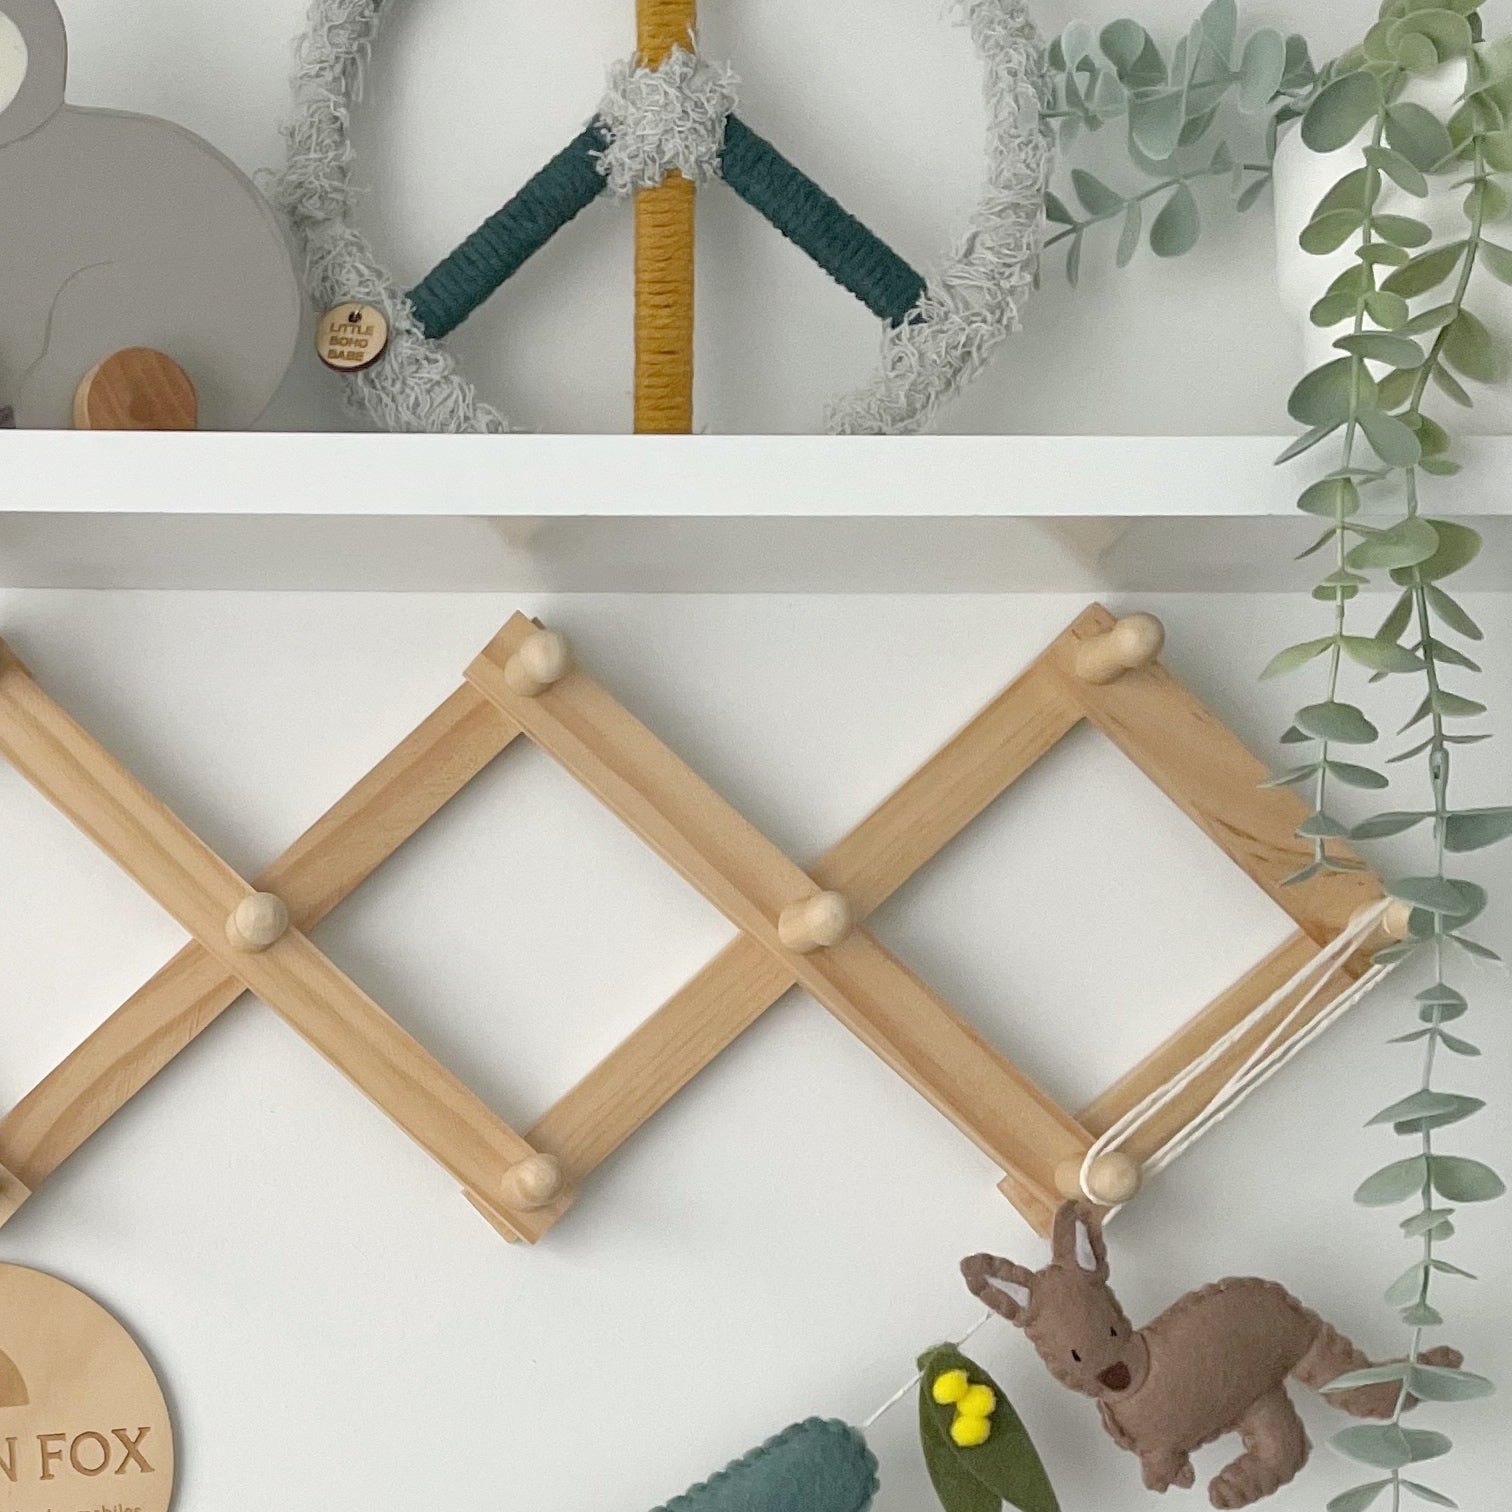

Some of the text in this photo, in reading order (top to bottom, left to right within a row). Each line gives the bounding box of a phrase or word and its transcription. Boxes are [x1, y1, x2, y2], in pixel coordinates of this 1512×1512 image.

[329, 322, 375, 336] LITTLE
[329, 335, 369, 349] BOHO
[327, 348, 366, 362] BABE
[37, 1426, 156, 1480] FOX
